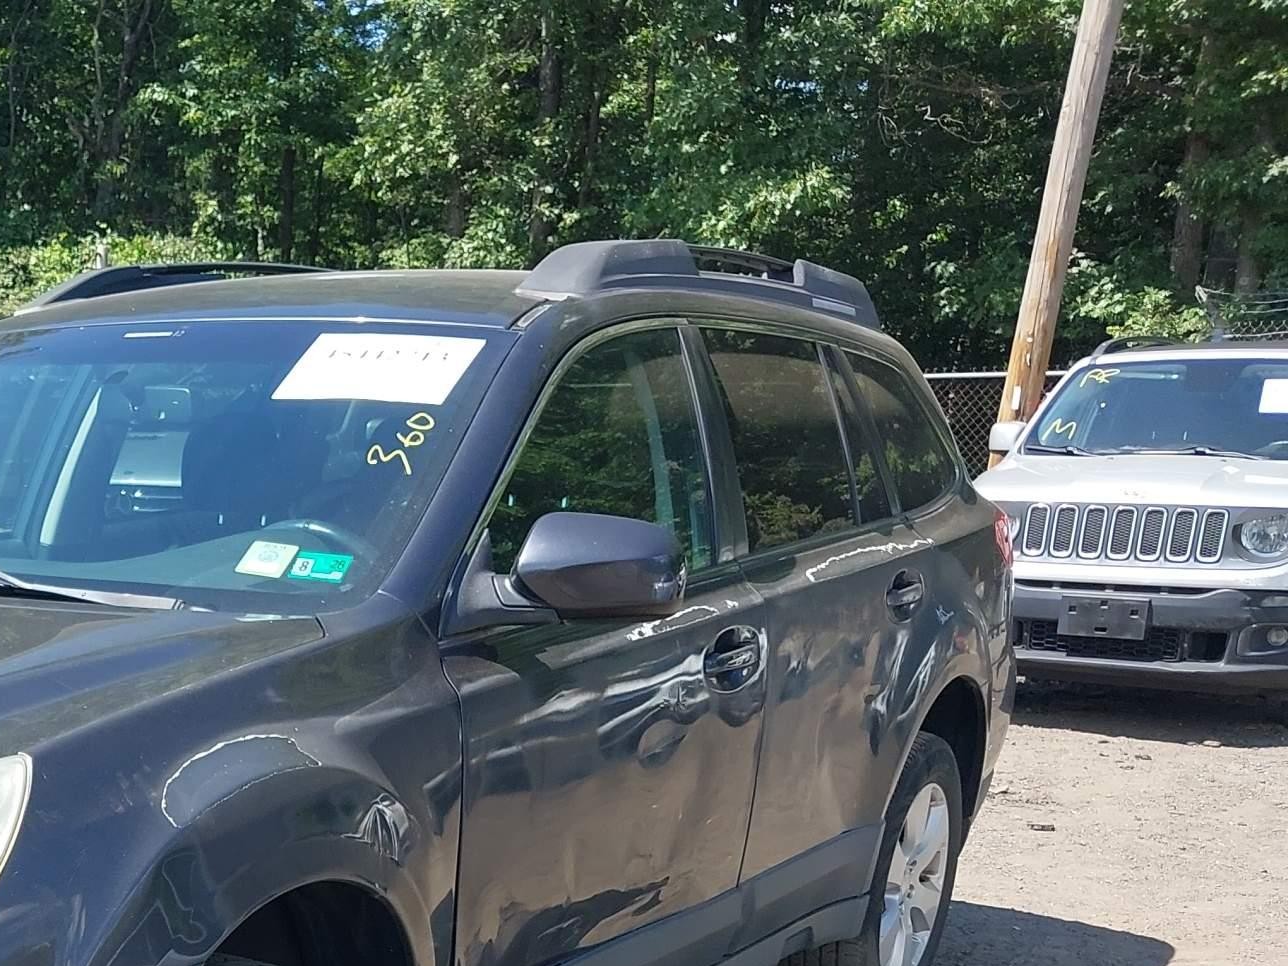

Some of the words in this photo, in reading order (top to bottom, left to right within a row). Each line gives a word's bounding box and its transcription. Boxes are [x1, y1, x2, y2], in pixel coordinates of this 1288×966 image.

[1041, 418, 1077, 440] M
[366, 411, 436, 476] 360
[298, 560, 310, 572] 8
